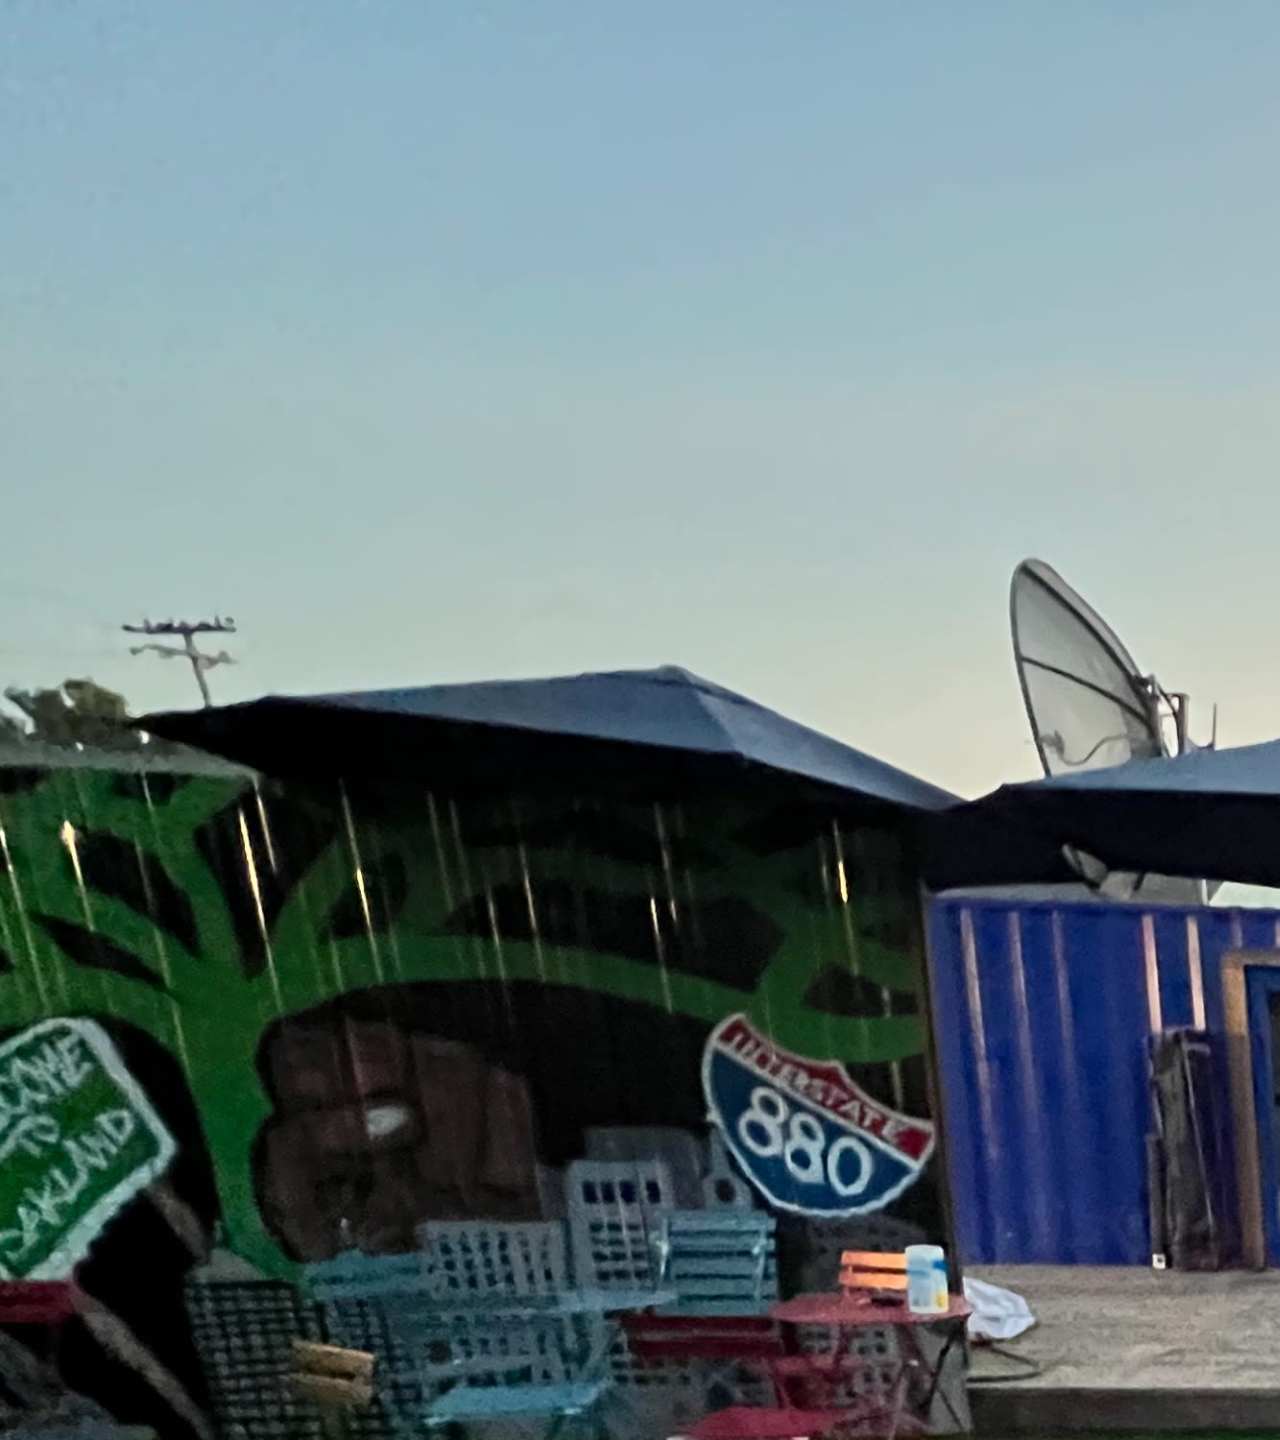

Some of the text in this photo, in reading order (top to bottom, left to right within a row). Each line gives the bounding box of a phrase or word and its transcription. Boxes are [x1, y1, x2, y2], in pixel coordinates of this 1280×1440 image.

[0, 1034, 93, 1130] COME
[0, 1113, 60, 1158] TO
[738, 1086, 872, 1197] 880
